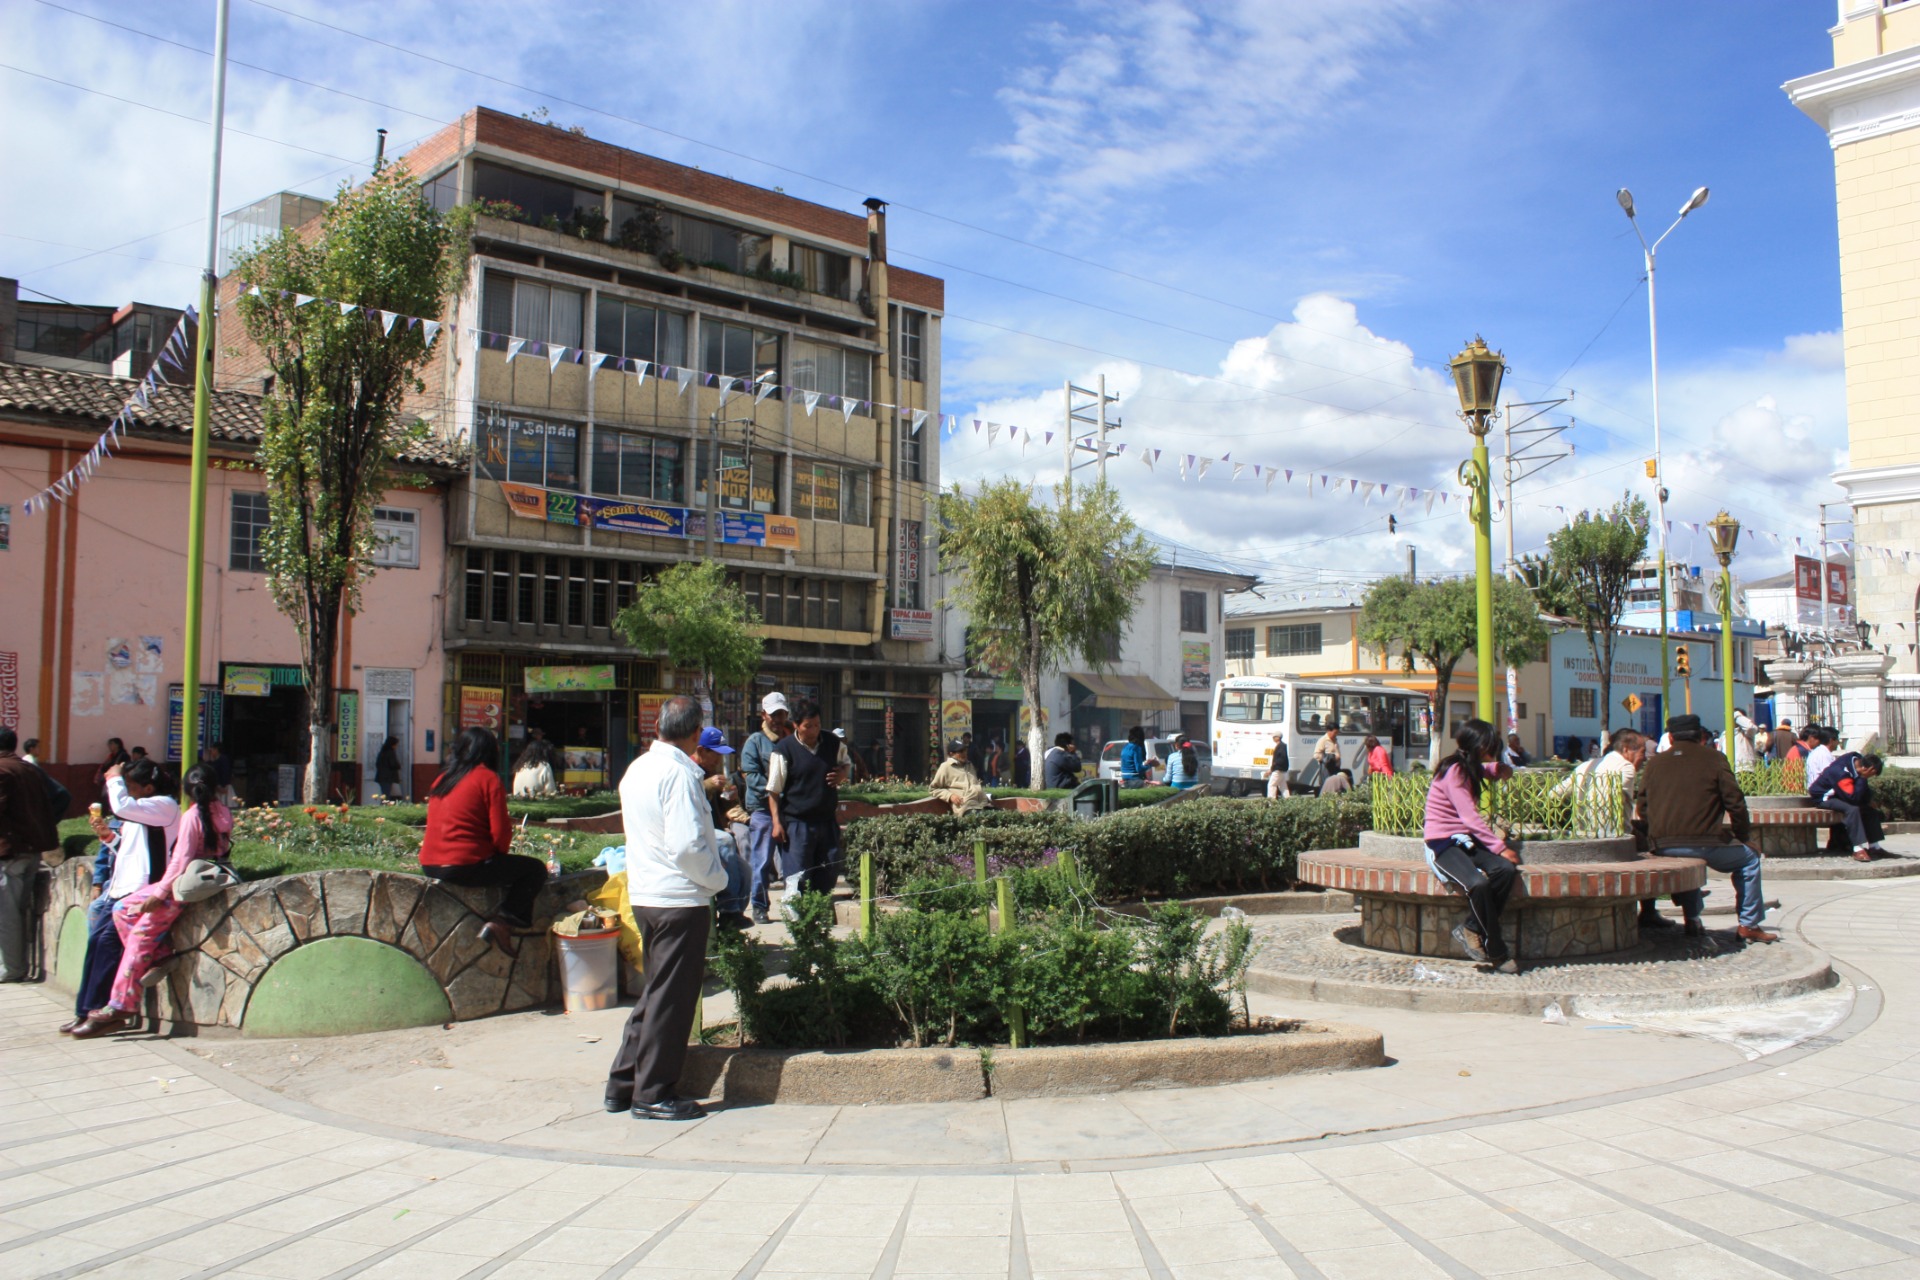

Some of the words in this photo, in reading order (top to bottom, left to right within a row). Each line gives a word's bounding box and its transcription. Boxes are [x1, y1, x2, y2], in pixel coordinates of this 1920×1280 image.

[723, 469, 749, 484] JAZZ
[701, 479, 776, 503] SONORAMA
[548, 493, 577, 516] 22
[801, 493, 838, 511] AMERICA
[603, 505, 636, 519] Santa
[771, 526, 795, 536] CRISTAL
[908, 523, 919, 579] FLORES
[892, 609, 910, 619] TUPAC
[912, 611, 933, 620] AMARU
[1614, 661, 1648, 675] EDUCATIVA
[0, 652, 17, 732] efrescate!!!
[341, 702, 350, 760] LOCUTORIO
